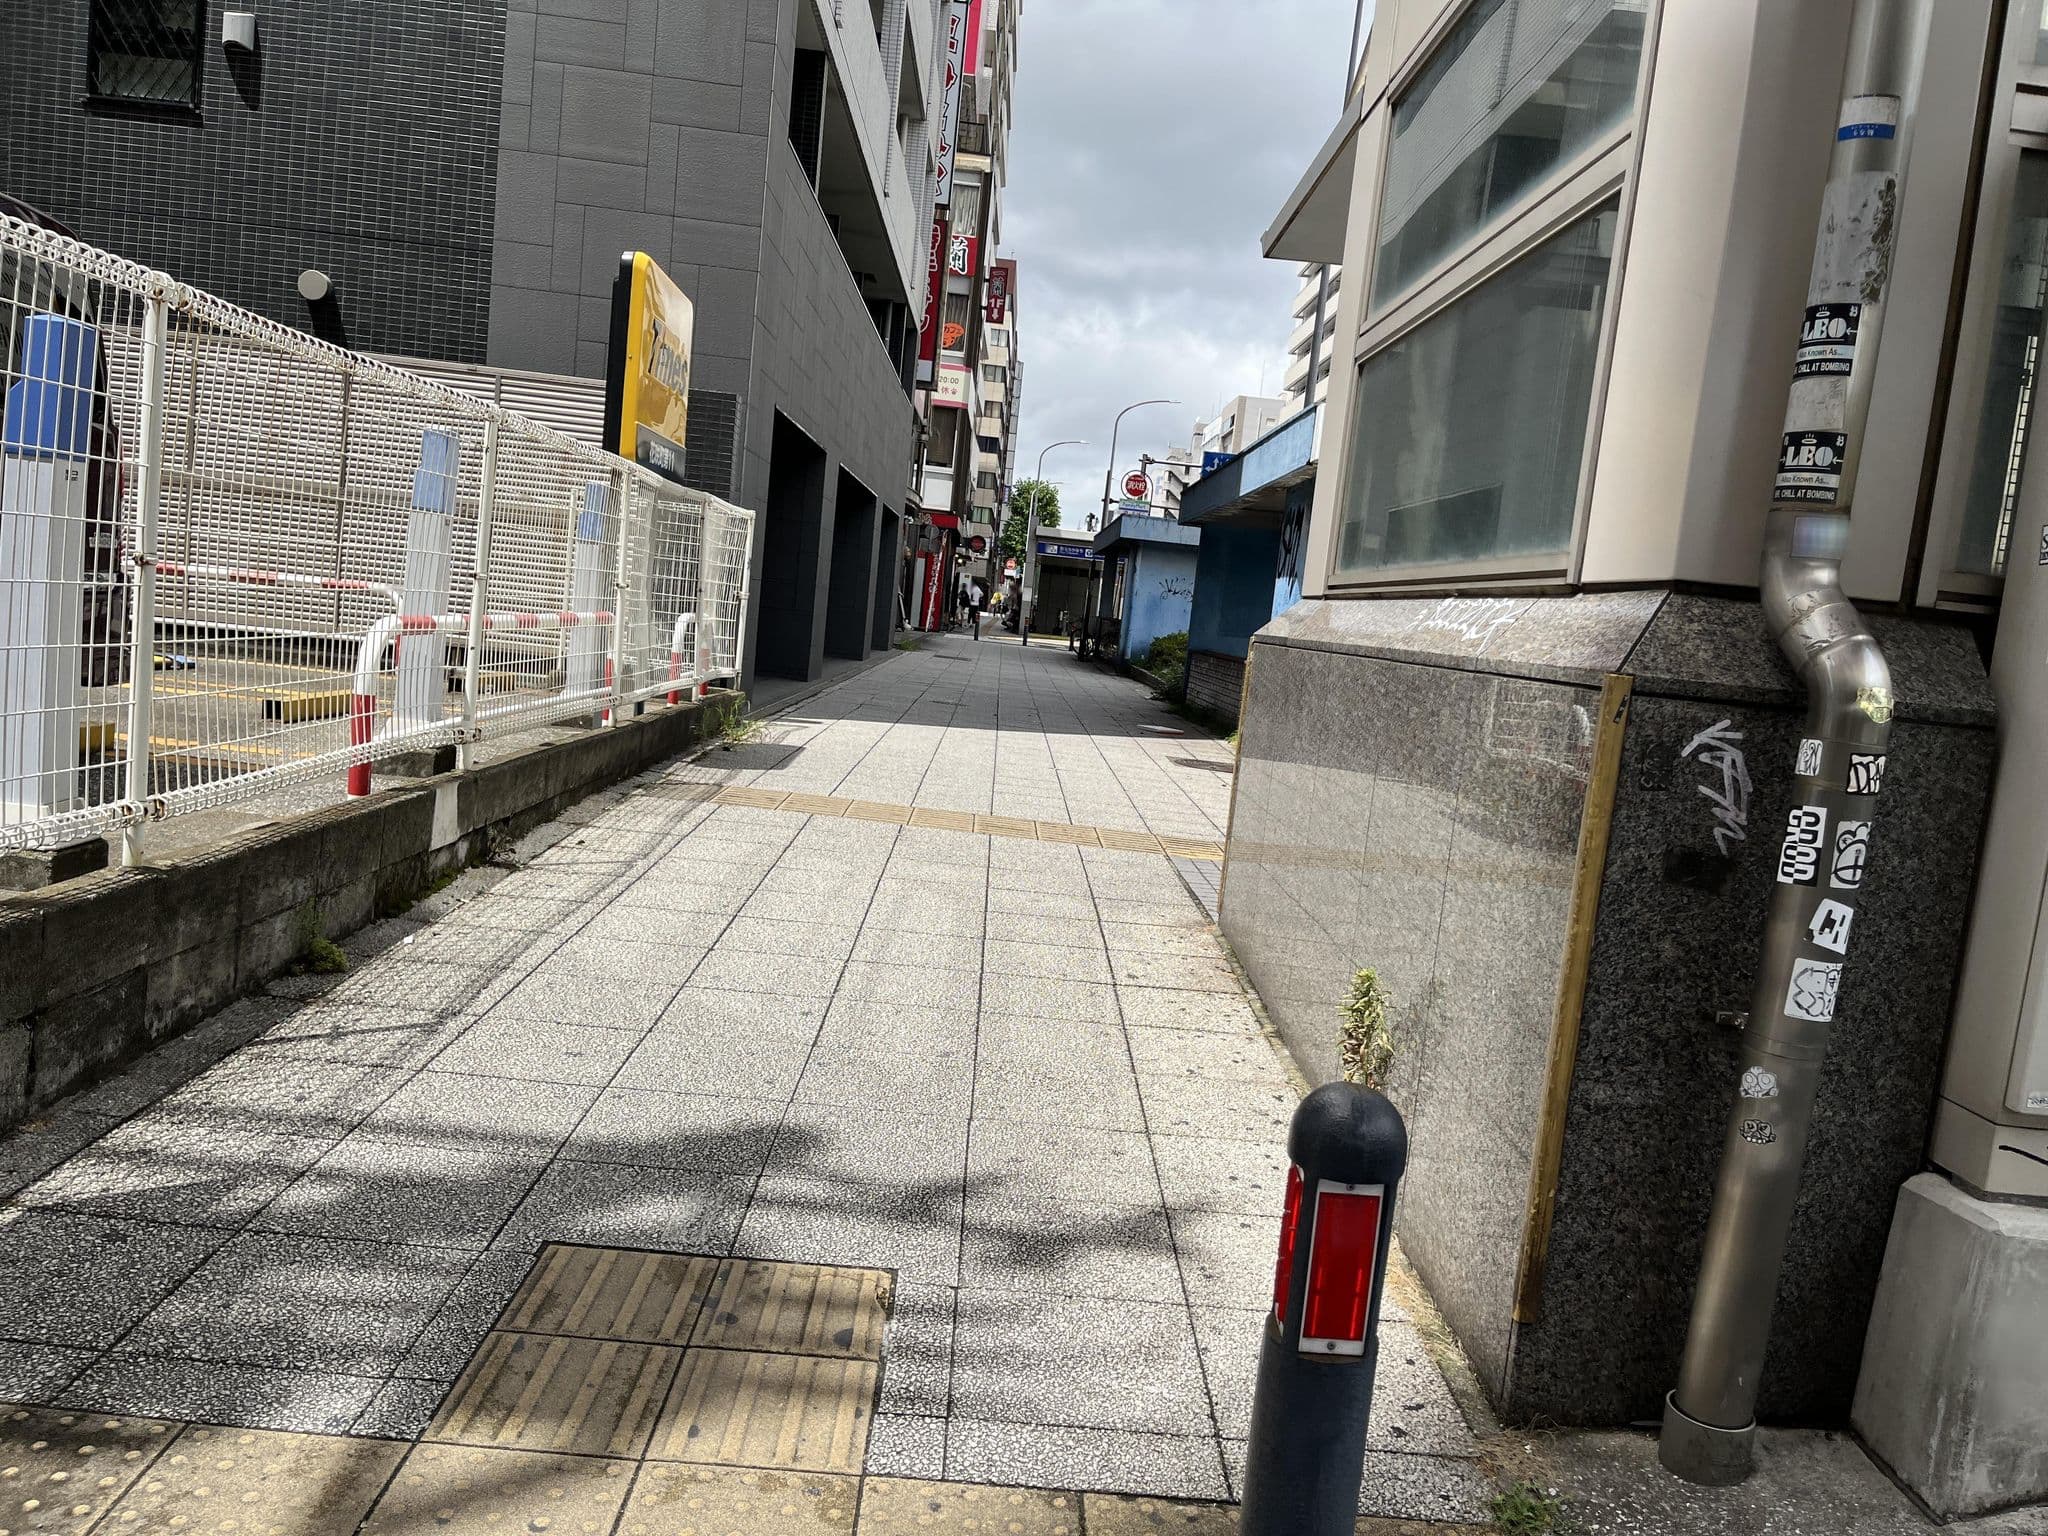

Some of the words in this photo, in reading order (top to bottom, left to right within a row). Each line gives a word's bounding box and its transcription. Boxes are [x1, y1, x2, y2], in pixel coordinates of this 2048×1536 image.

[989, 298, 1004, 308] 1F
[1803, 318, 1847, 341] LEO
[1811, 362, 1820, 372] AT
[1820, 362, 1850, 372] BOMBING
[1785, 446, 1834, 467] LEO
[1792, 474, 1813, 483] Known
[1781, 489, 1796, 499] CHILL
[1796, 489, 1806, 499] AT
[1806, 489, 1835, 500] BOMBING
